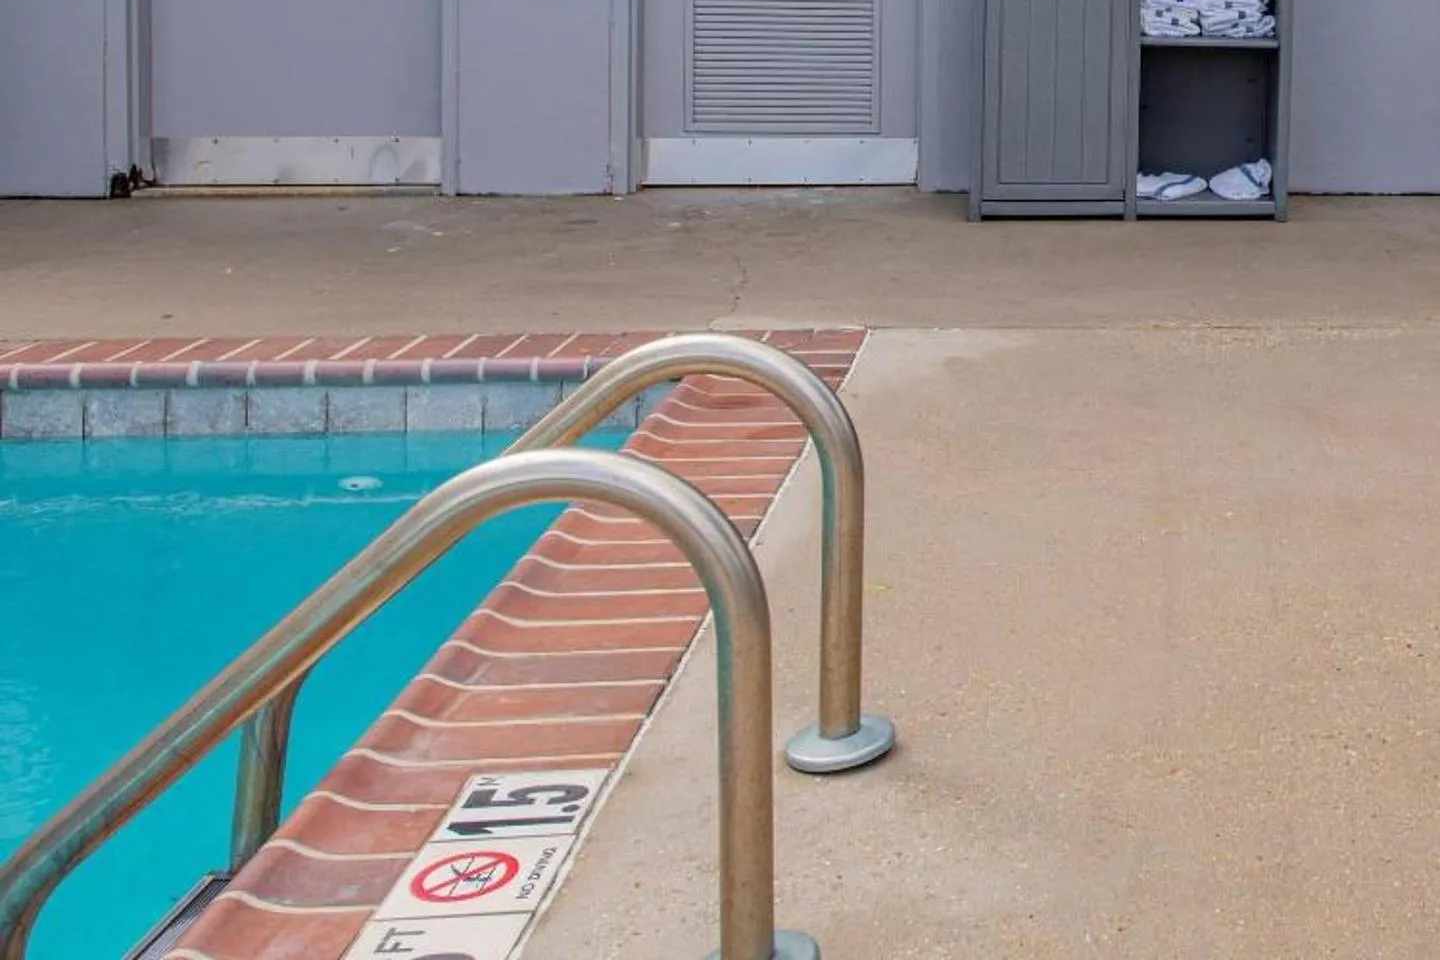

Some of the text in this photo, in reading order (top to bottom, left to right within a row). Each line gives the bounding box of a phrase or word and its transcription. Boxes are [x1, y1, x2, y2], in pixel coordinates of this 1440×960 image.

[446, 783, 590, 836] 1.5
[515, 847, 557, 900] NO DIVING
[374, 927, 426, 954] FT
